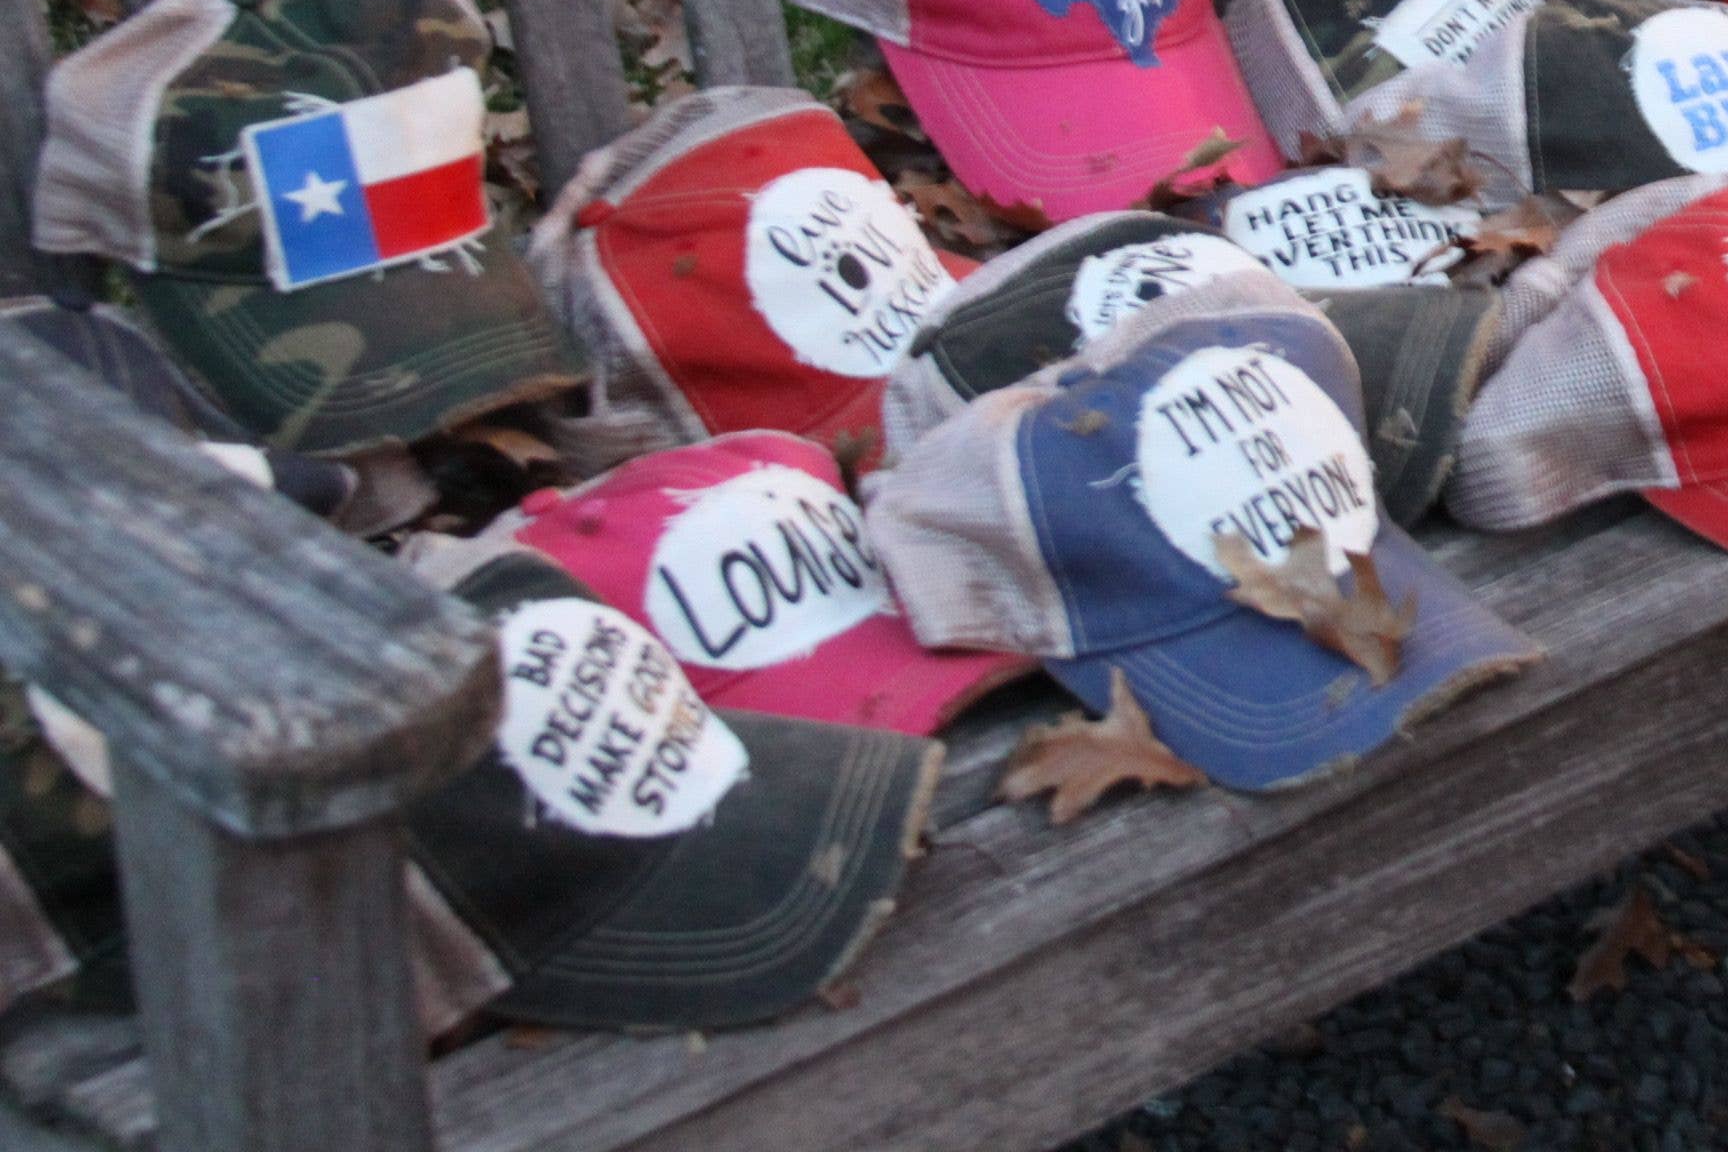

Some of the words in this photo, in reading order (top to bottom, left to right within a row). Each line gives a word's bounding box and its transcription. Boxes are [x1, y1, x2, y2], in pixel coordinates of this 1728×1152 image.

[1281, 209, 1347, 241] LET
[1359, 198, 1416, 221] ME
[1325, 242, 1411, 277] THIS
[1156, 389, 1235, 457] I'M
[1214, 358, 1291, 425] NOT
[1238, 427, 1292, 481] FOR
[511, 628, 566, 688] BAD
[530, 617, 628, 767] DECISIONS
[569, 711, 644, 815] MAKE
